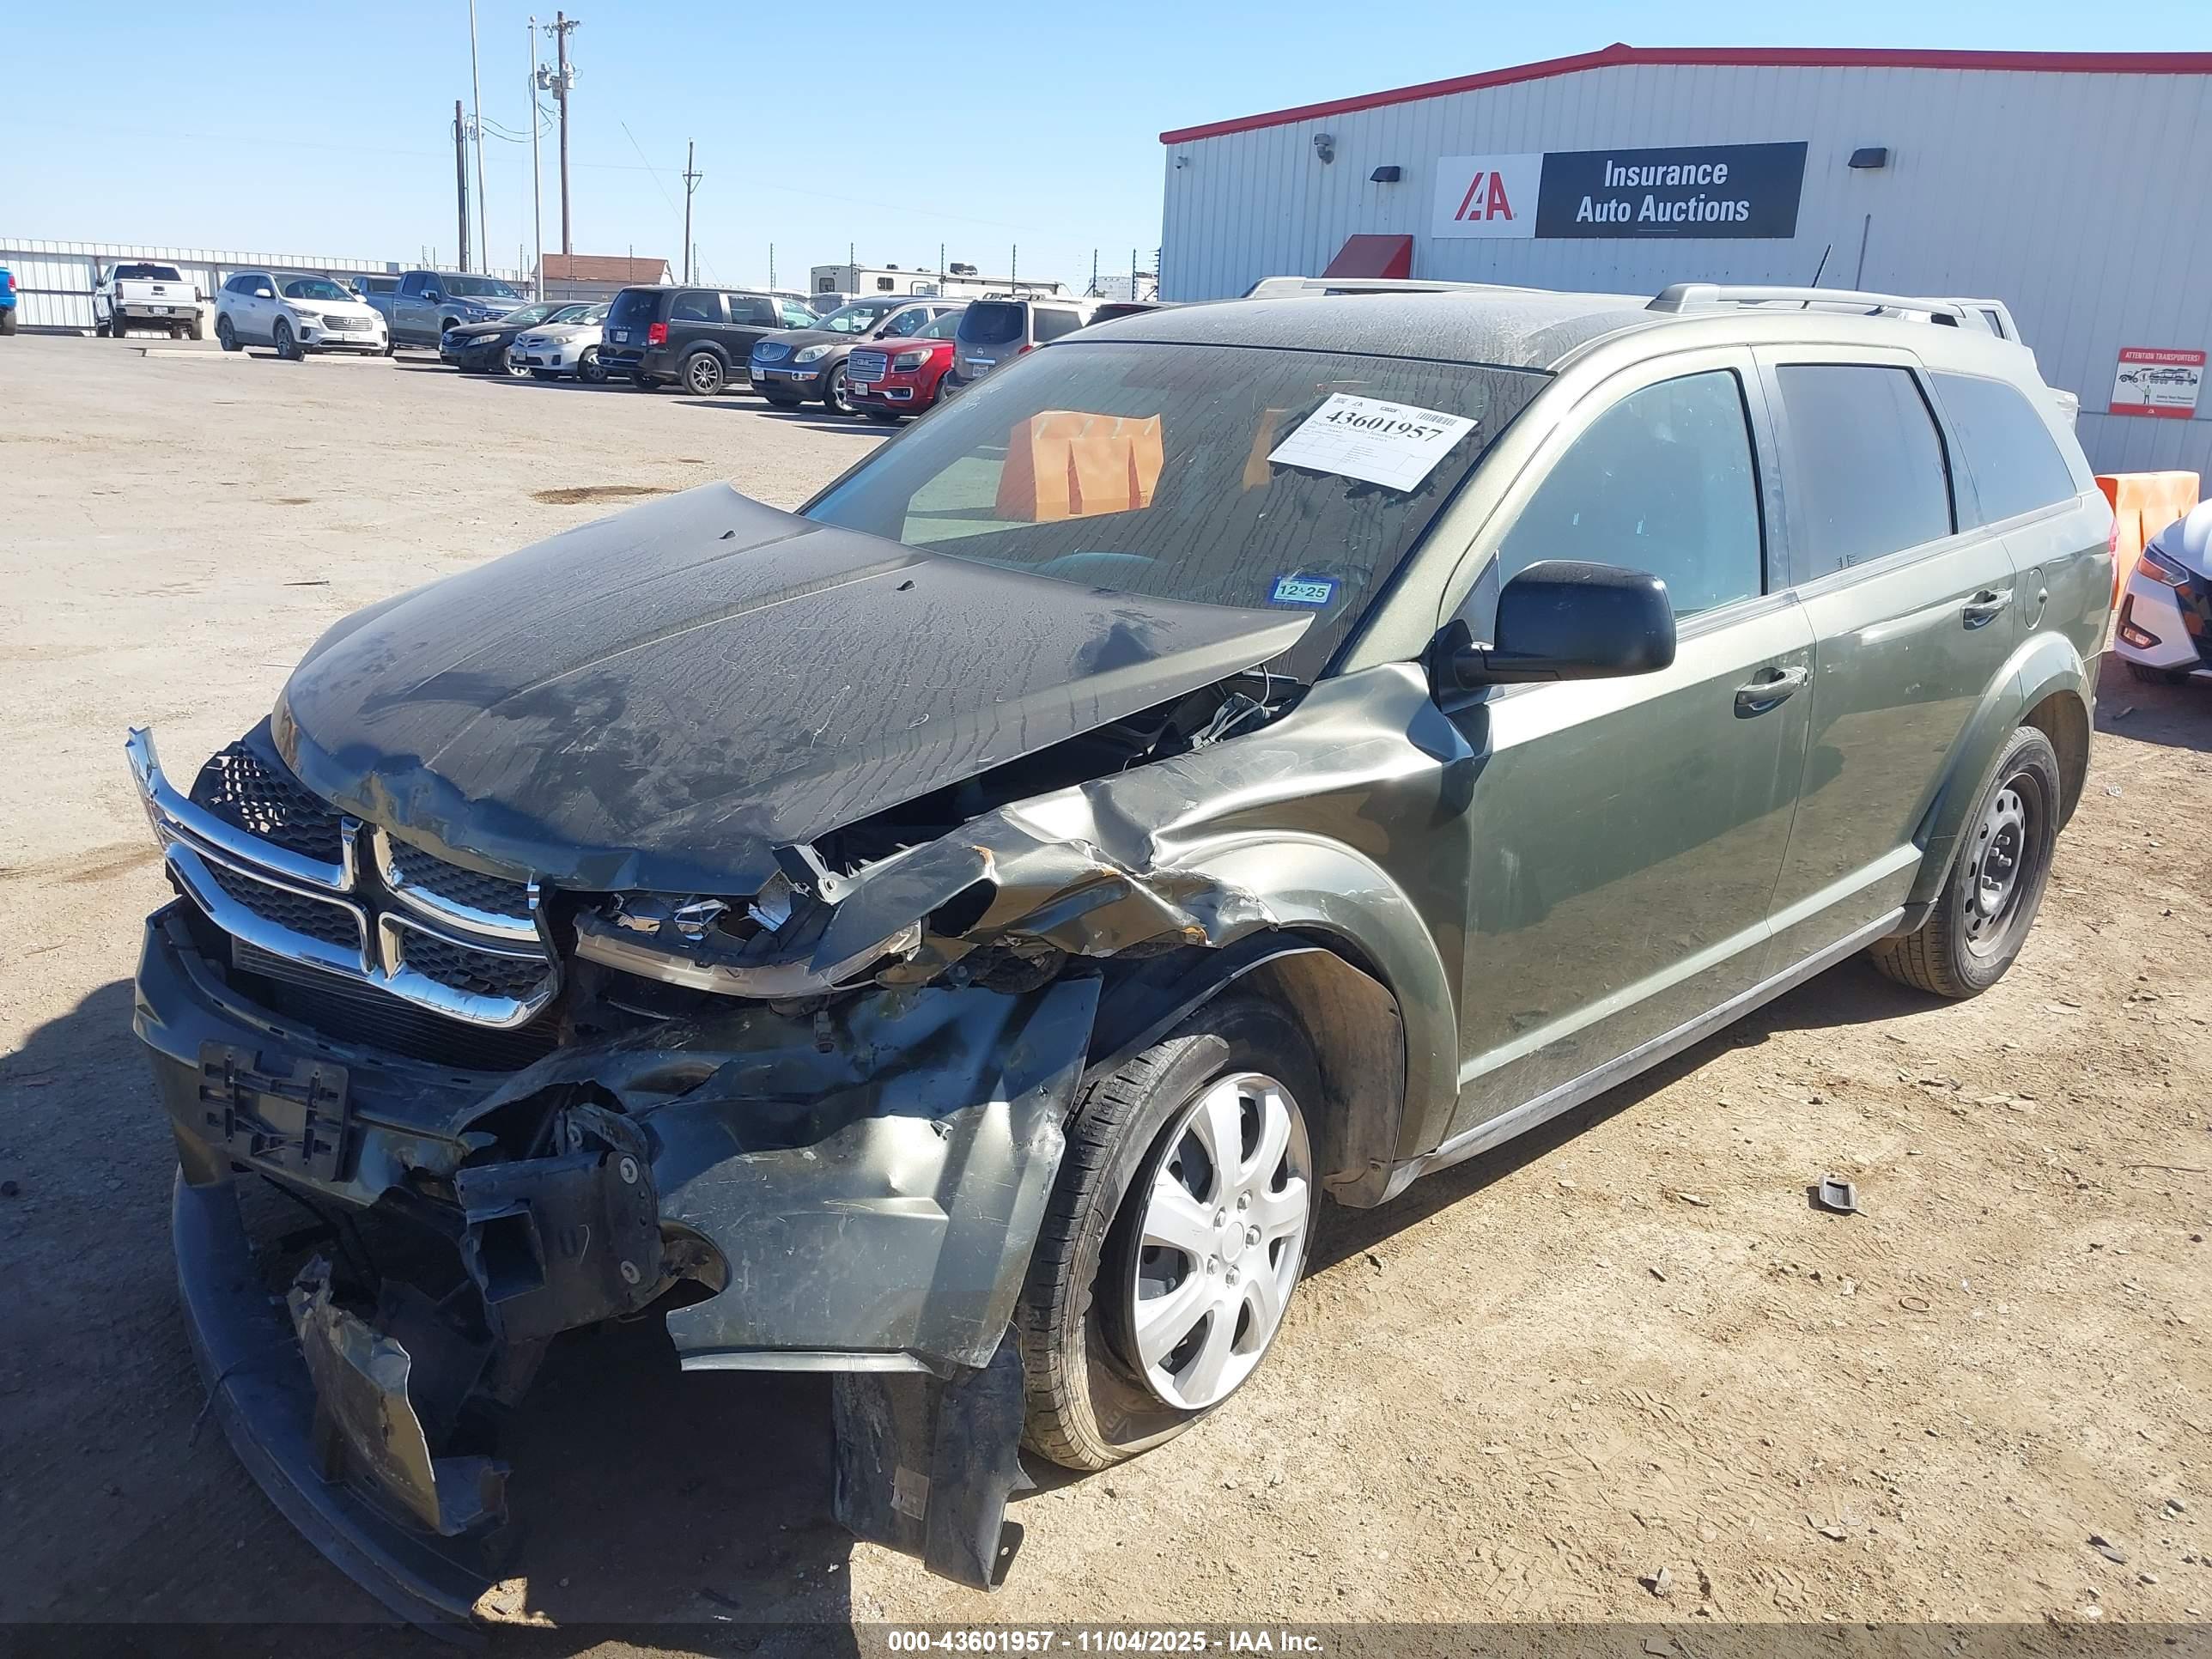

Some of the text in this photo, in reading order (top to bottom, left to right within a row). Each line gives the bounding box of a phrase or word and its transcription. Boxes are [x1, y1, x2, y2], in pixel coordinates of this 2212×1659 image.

[1604, 160, 1728, 187] Insurance
[1576, 193, 1750, 222] Auto Auctions
[2124, 351, 2154, 360] ATTENTION
[1326, 410, 1443, 442] 43601957
